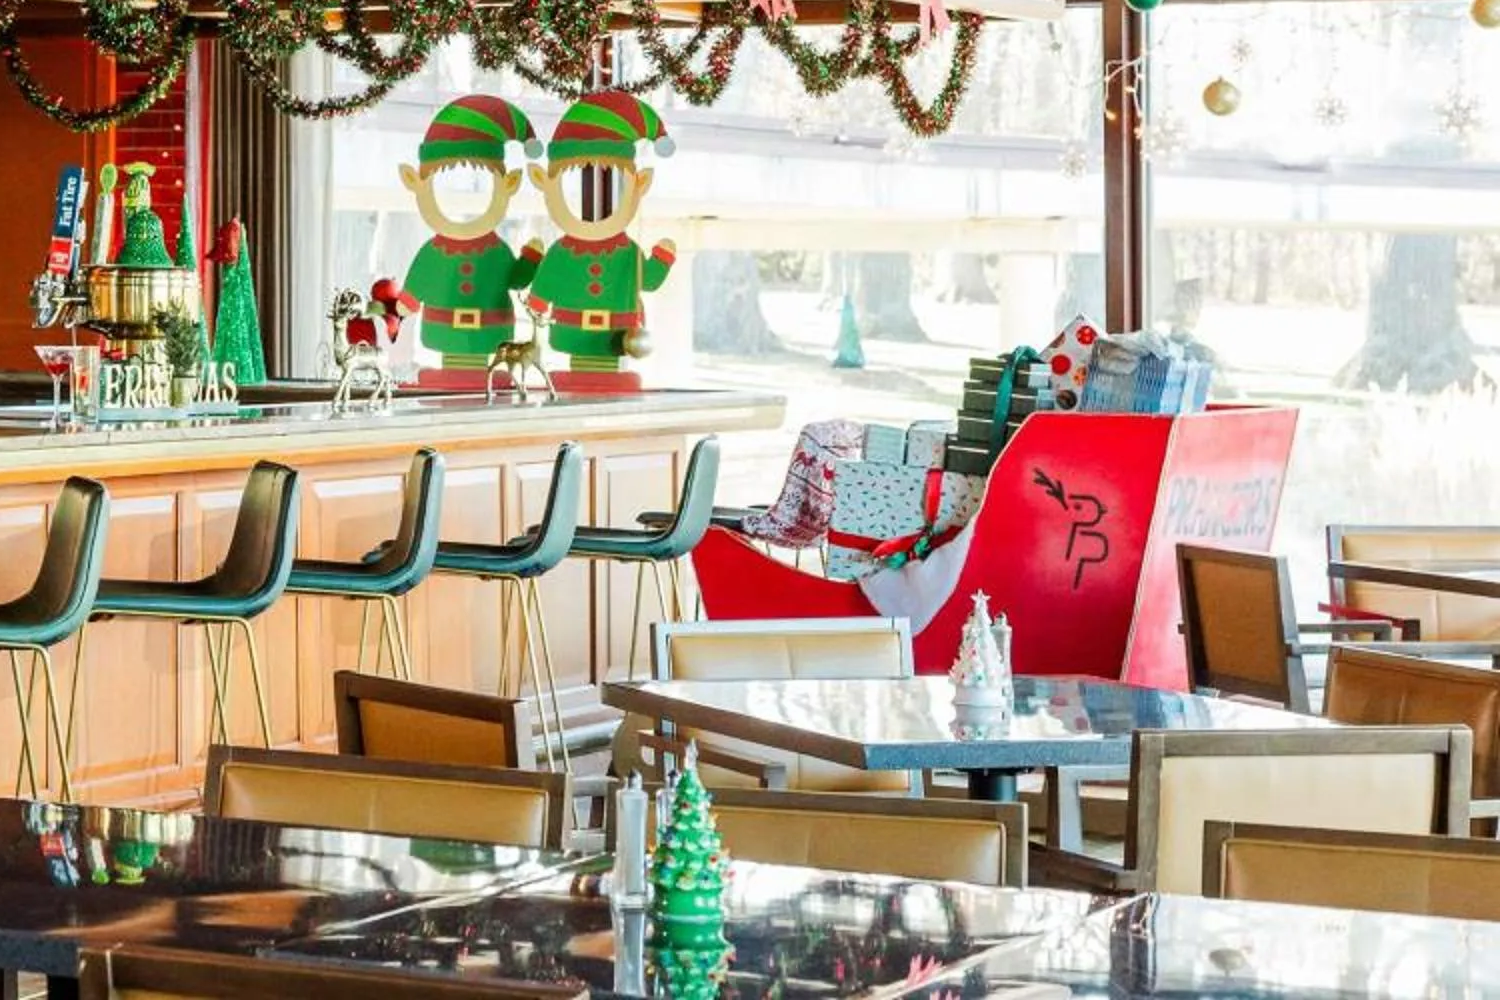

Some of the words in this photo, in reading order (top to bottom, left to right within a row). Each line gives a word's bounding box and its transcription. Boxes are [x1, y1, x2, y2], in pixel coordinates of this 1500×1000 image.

[61, 176, 78, 203] Tire
[58, 205, 74, 227] Fat
[103, 362, 174, 409] ERRY
